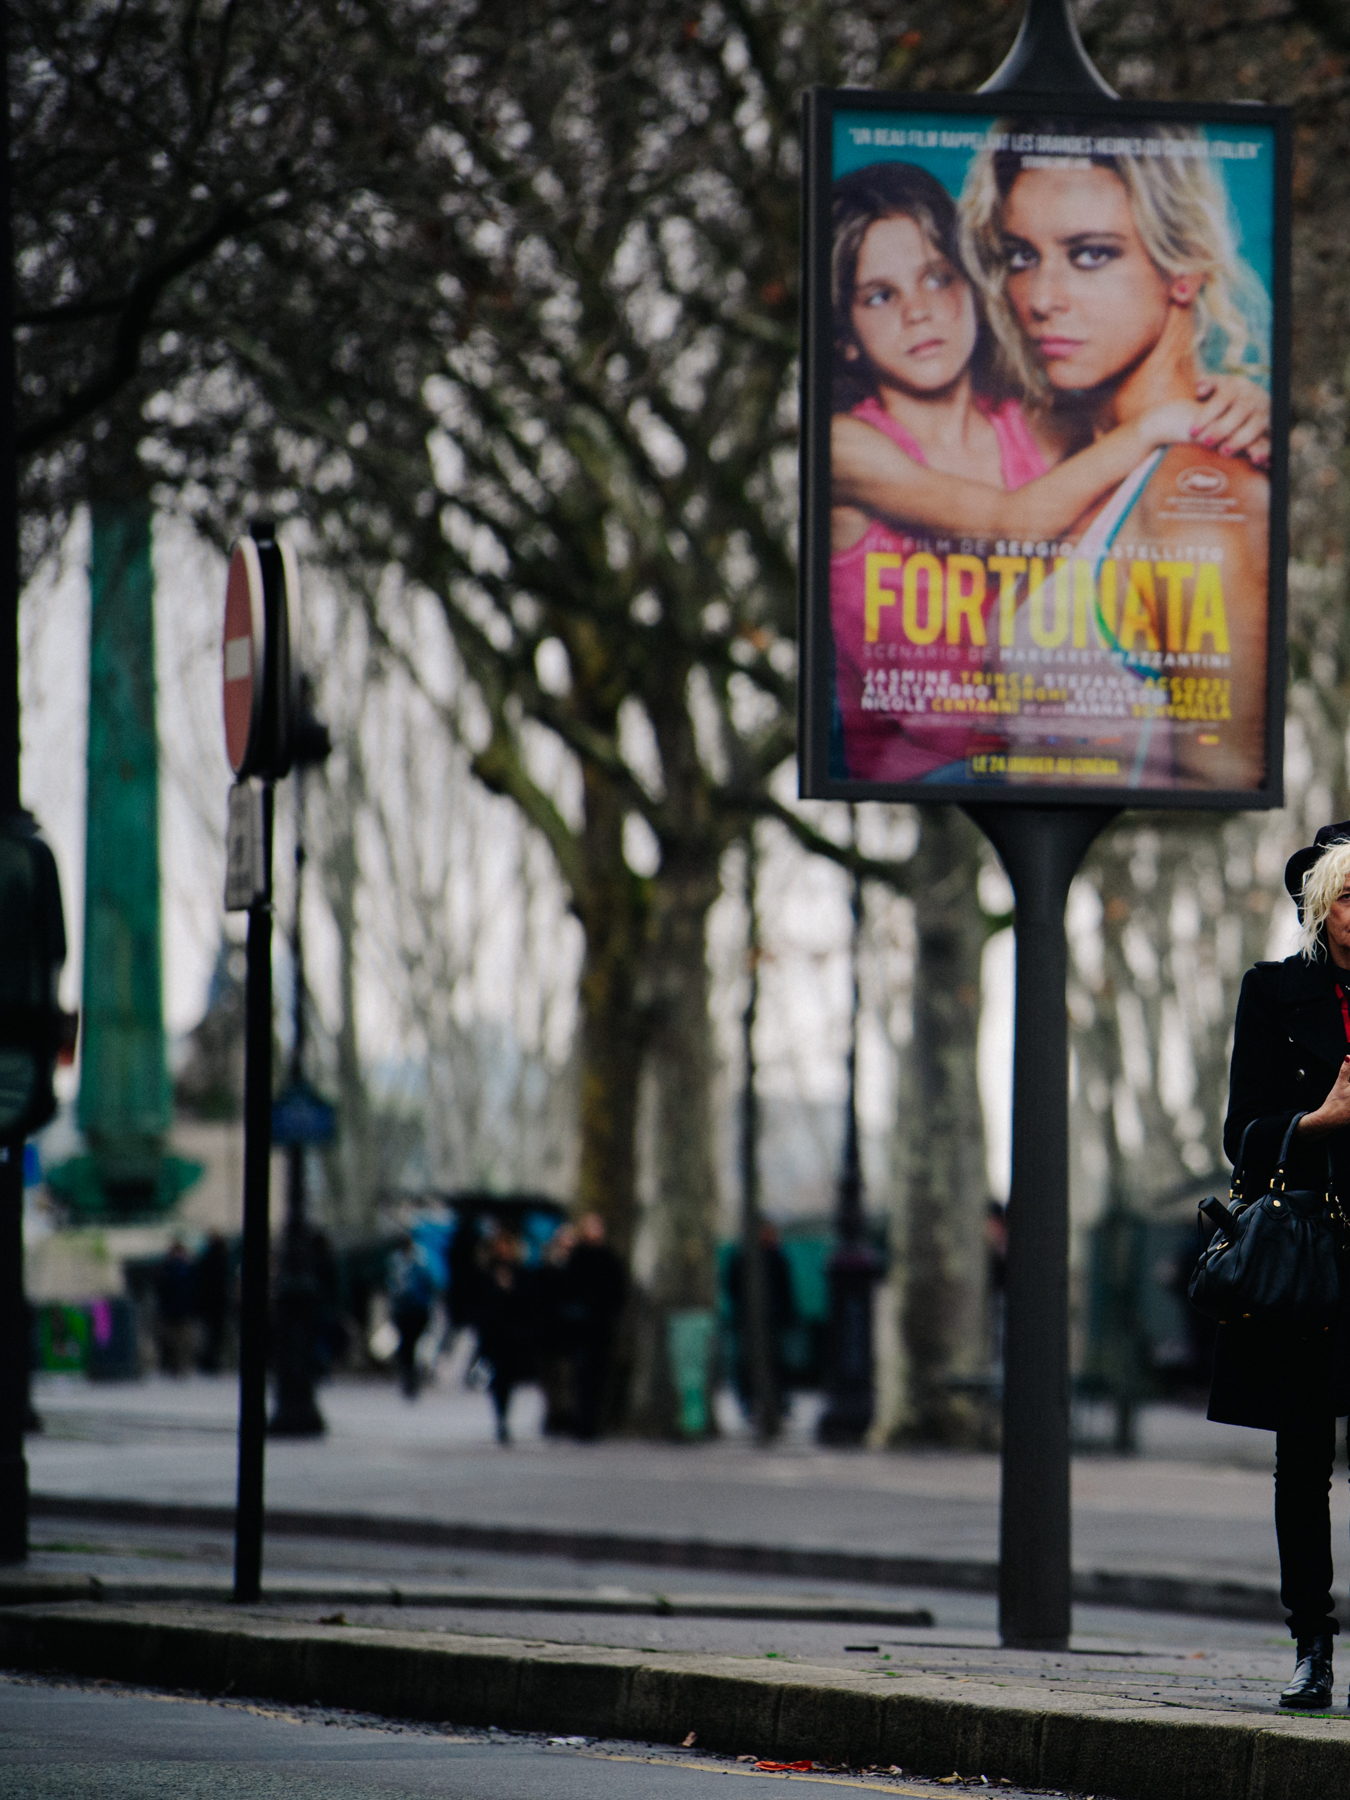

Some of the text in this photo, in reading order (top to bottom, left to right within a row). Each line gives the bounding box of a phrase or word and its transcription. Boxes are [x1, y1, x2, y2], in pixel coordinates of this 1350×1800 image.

[1011, 133, 1034, 153] LES
[902, 537, 951, 553] FILM
[960, 539, 987, 555] DE
[995, 540, 1074, 557] SERGIO
[864, 551, 1231, 653] FORTUNATA
[967, 645, 992, 663] DE
[1000, 648, 1107, 665] MARGARET
[1111, 651, 1231, 669] MAZZANTINI
[863, 668, 1231, 692] JASMINE TRINCA STEFANO ACCORSI
[863, 683, 989, 700] ALESSANDRO
[994, 685, 1068, 702] BORGHI
[861, 696, 926, 713] NICOLE
[931, 698, 1020, 715] CENTANNI
[1064, 702, 1127, 717] HANNA
[989, 755, 1006, 773] 24
